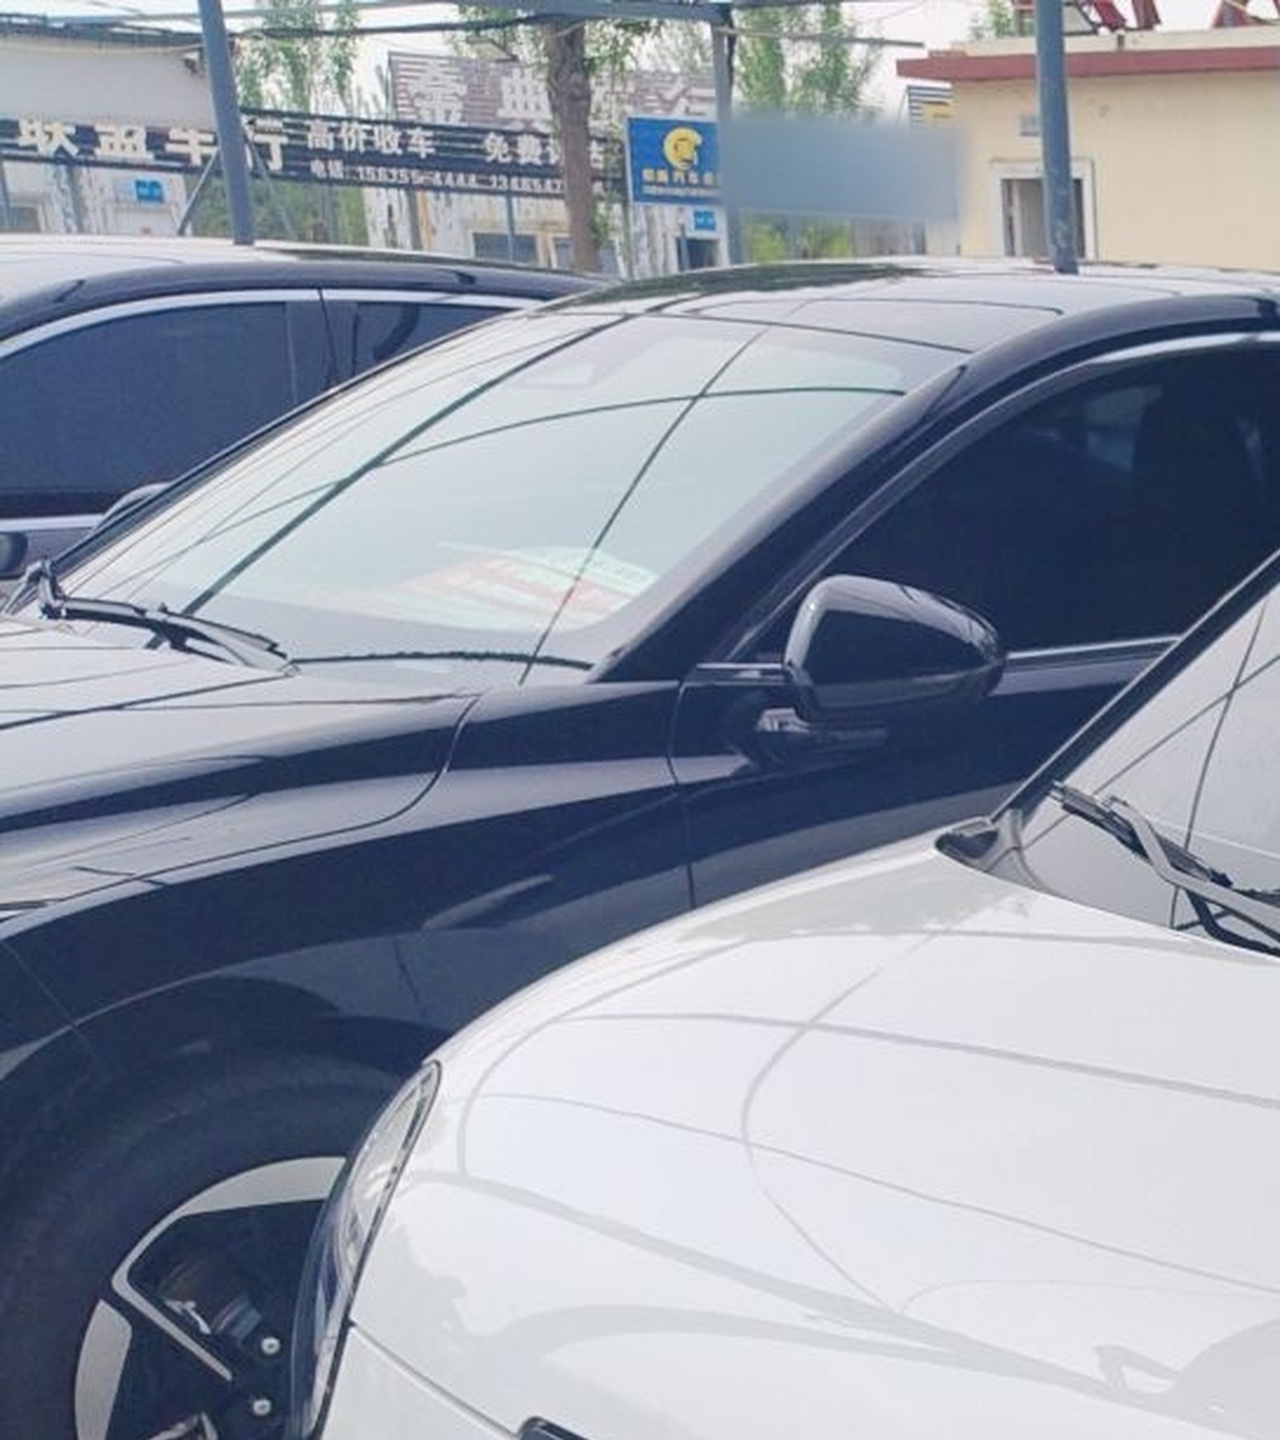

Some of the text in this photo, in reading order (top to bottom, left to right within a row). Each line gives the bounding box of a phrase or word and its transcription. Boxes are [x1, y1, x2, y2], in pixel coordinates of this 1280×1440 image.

[17, 116, 289, 171] 联盟车行
[303, 119, 605, 170] 高价收车 免费估
